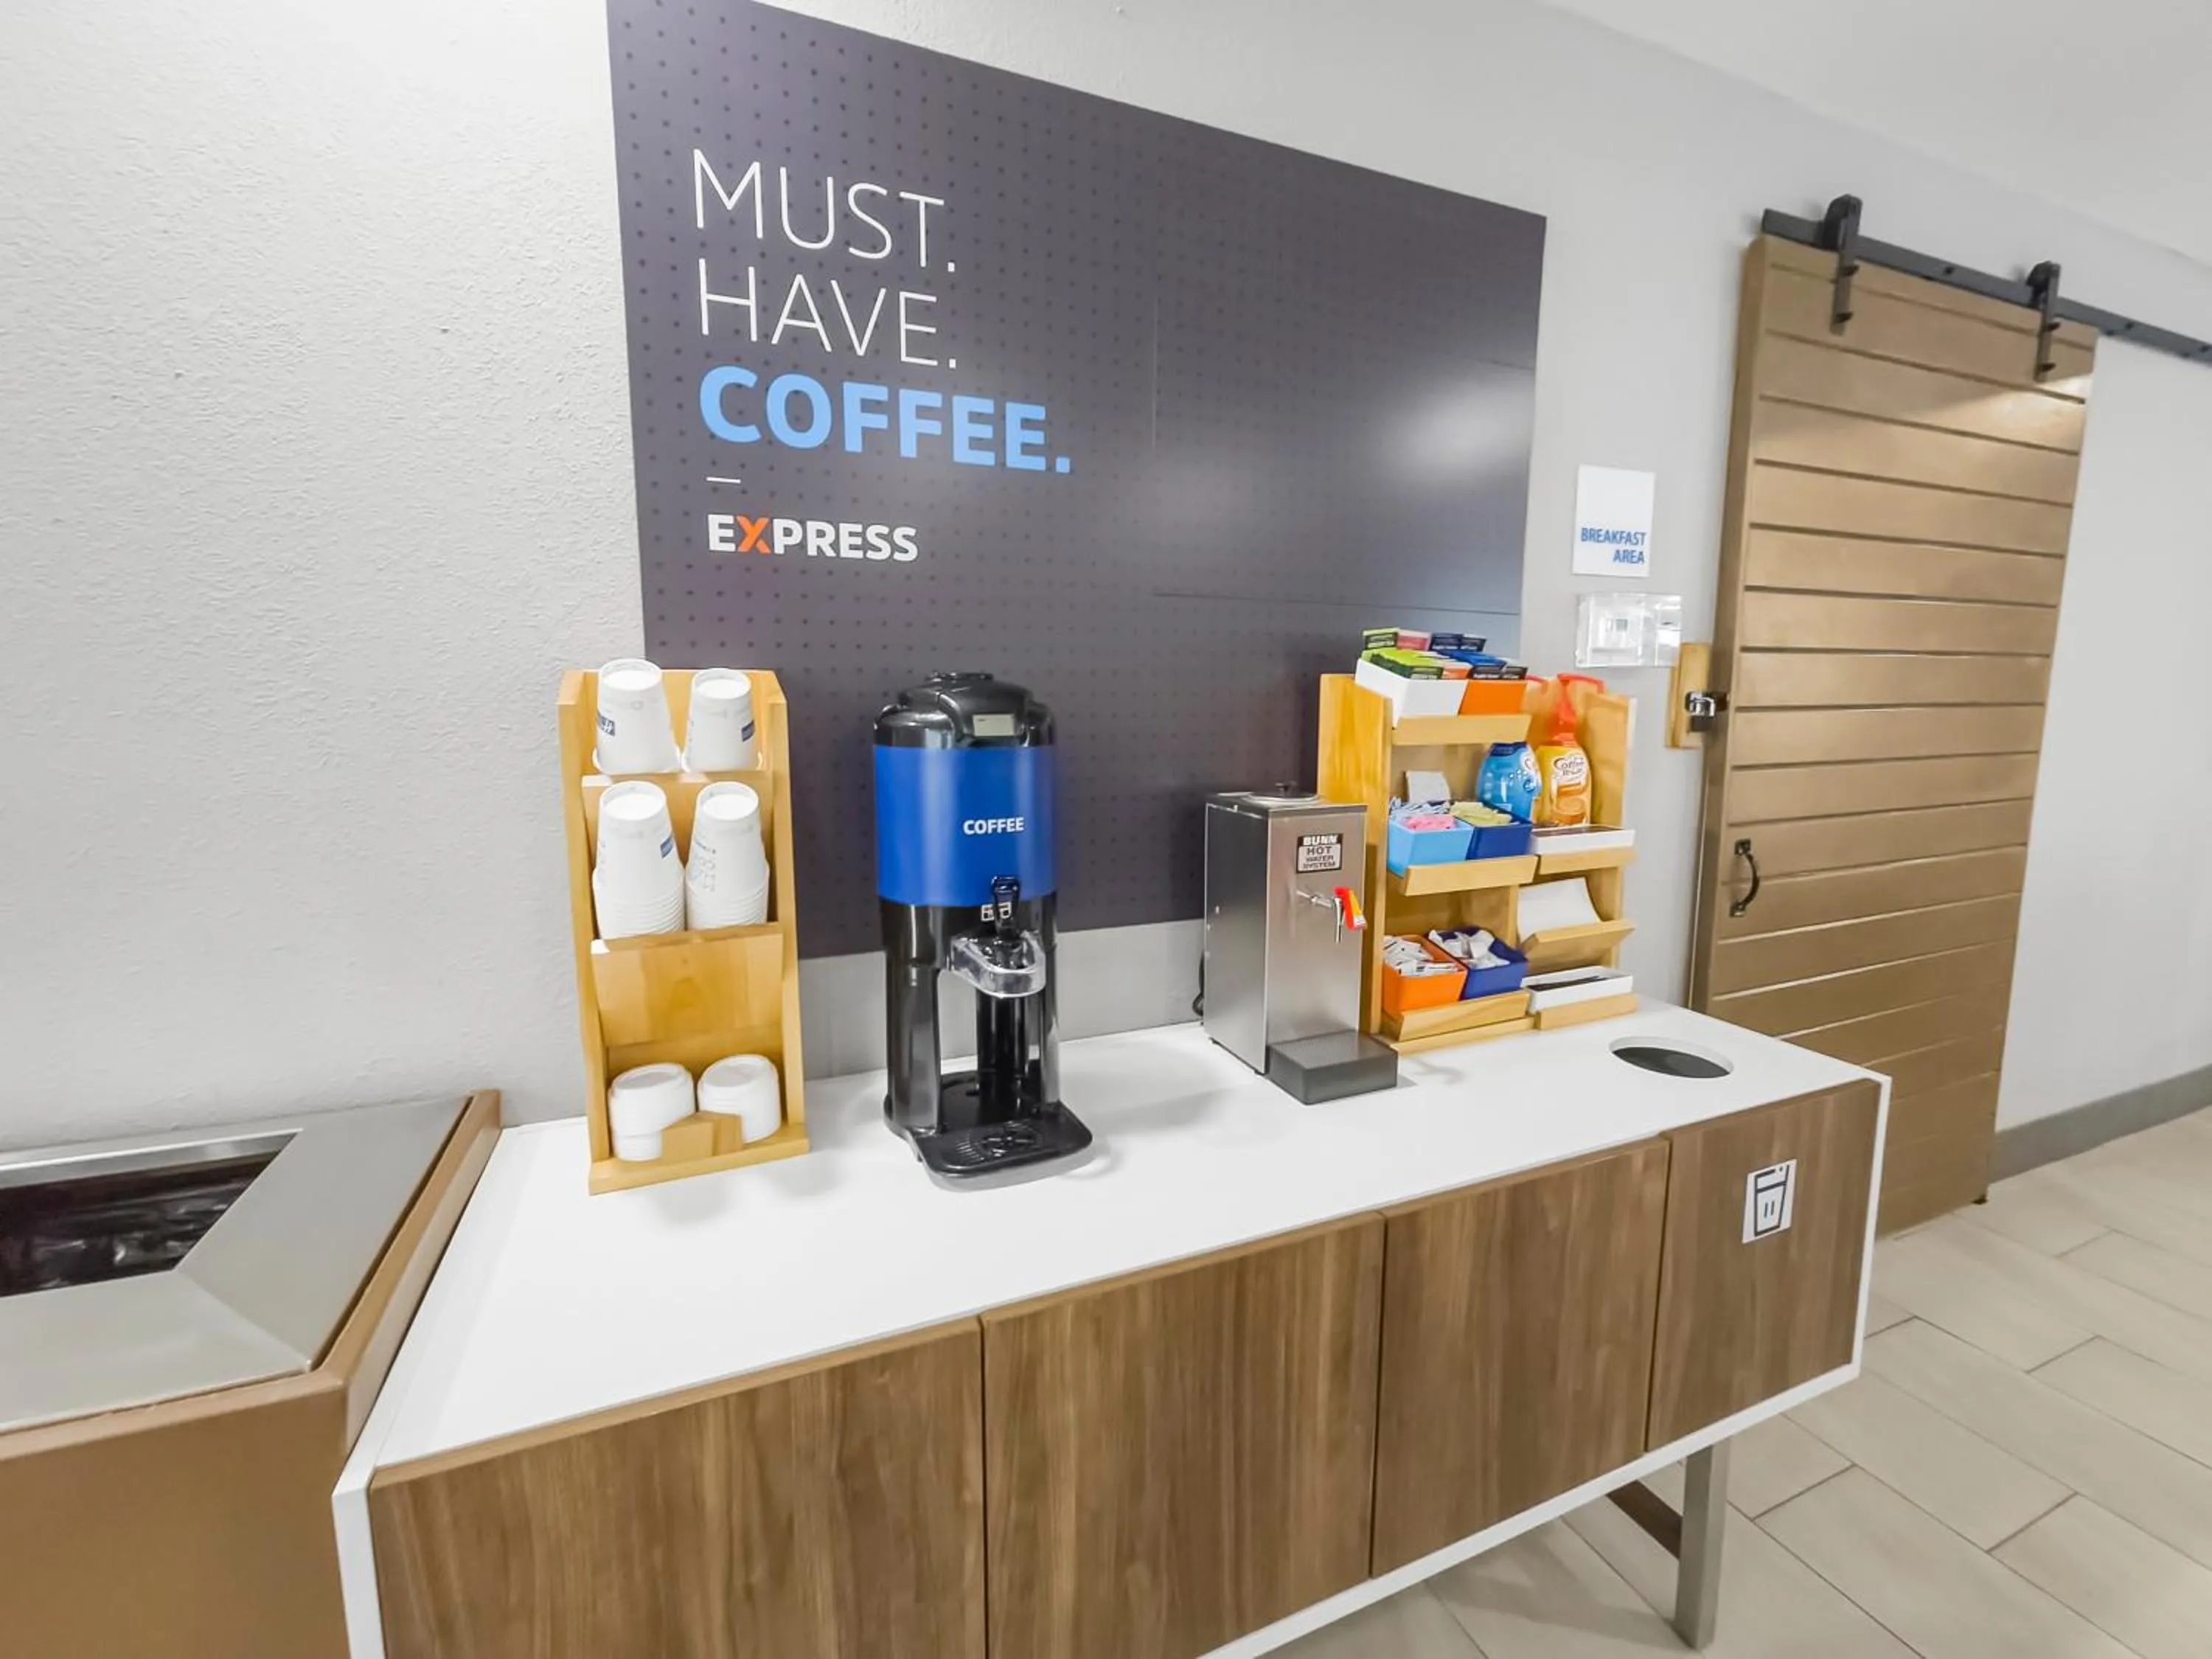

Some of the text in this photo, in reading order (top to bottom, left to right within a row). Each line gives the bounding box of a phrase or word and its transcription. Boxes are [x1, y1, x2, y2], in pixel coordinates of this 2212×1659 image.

[693, 148, 956, 272] MUST.
[698, 257, 956, 369] HAVE.
[699, 365, 1071, 473] COFFEE.
[706, 513, 919, 562] EXPRESS
[1580, 526, 1647, 546] BREAKFAST
[1613, 549, 1645, 564] AREA
[963, 817, 1024, 835] COFFEE
[1303, 835, 1337, 846] BUNN
[1307, 846, 1332, 855] HOT
